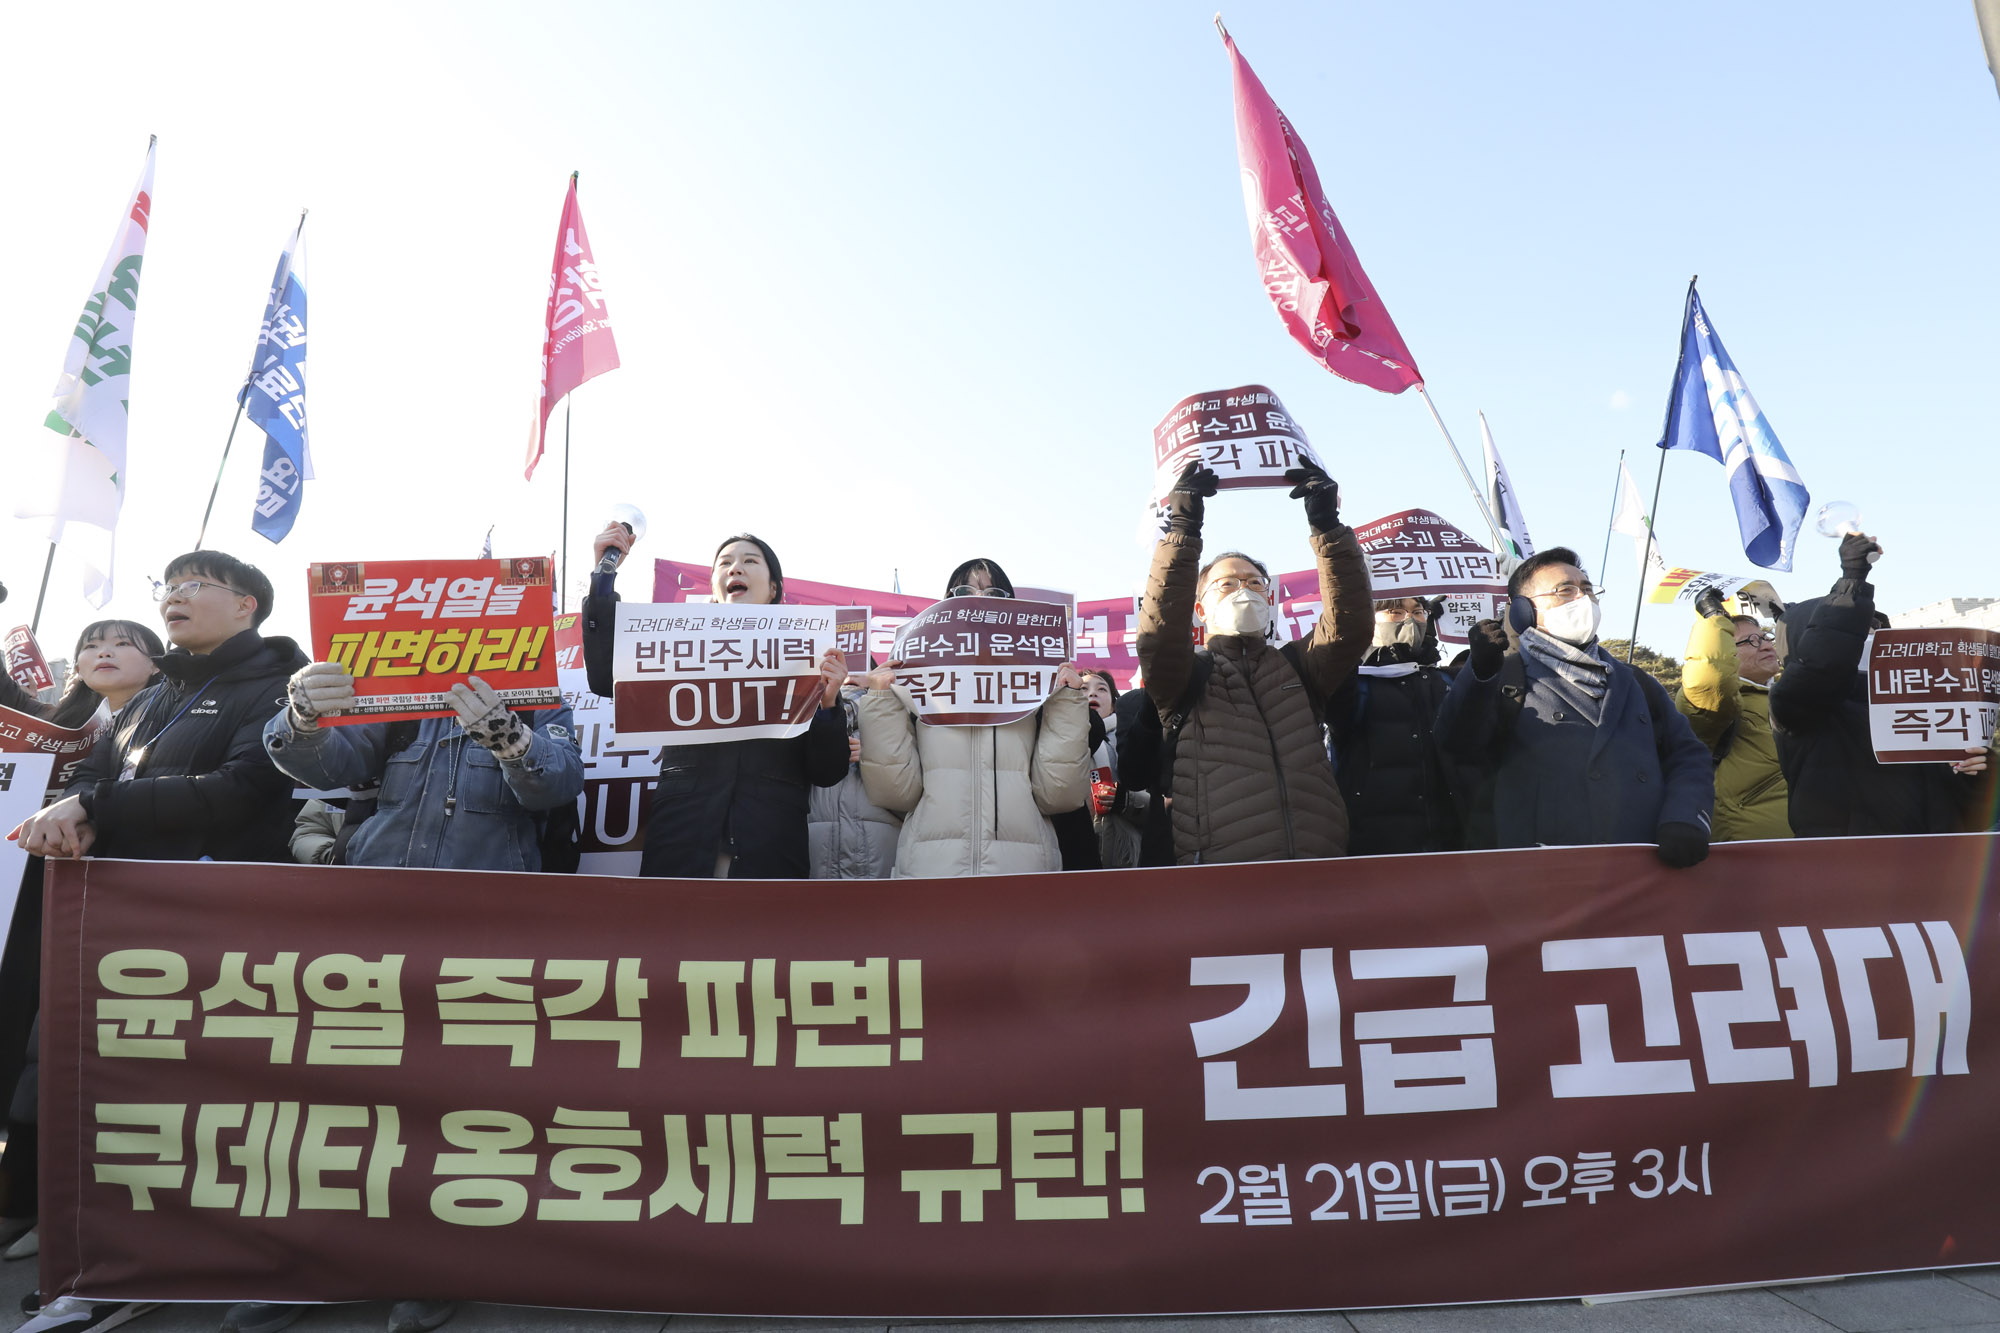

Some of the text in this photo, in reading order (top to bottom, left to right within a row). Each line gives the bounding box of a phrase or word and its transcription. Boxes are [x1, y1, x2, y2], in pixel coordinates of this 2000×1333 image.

[1158, 412, 1257, 461] 내란수괴
[1159, 399, 1221, 440] 고려대학교
[1355, 517, 1405, 541] 려대학교
[1372, 556, 1500, 582] 즉각 파면!
[343, 577, 526, 621] 윤석열을
[1447, 602, 1482, 613] 압도적
[624, 617, 829, 633] 고려대학교 학생들이 말한다!
[956, 609, 1013, 624] 학생들이
[1016, 613, 1062, 628] 말한다!
[1454, 615, 1477, 627] 가결
[326, 625, 550, 677] 파면하라!
[635, 638, 815, 673] 반민주세력
[989, 633, 1066, 659] 윤석열
[1875, 642, 1953, 658] 고려대학교
[1957, 639, 1989, 656] 학생들이
[896, 671, 961, 706] 즉각
[1874, 667, 1980, 694] 내란수괴
[669, 679, 797, 727] OUT!
[1892, 707, 1972, 742] 즉각
[97, 949, 923, 1068] 윤석열 즉각 파면!
[1190, 921, 1972, 1121] 긴급 고려대
[94, 1102, 1145, 1226] 쿠데타 옹호세력 규탄!
[1197, 1143, 1712, 1225] 2월 21일(금) 오후 3시
